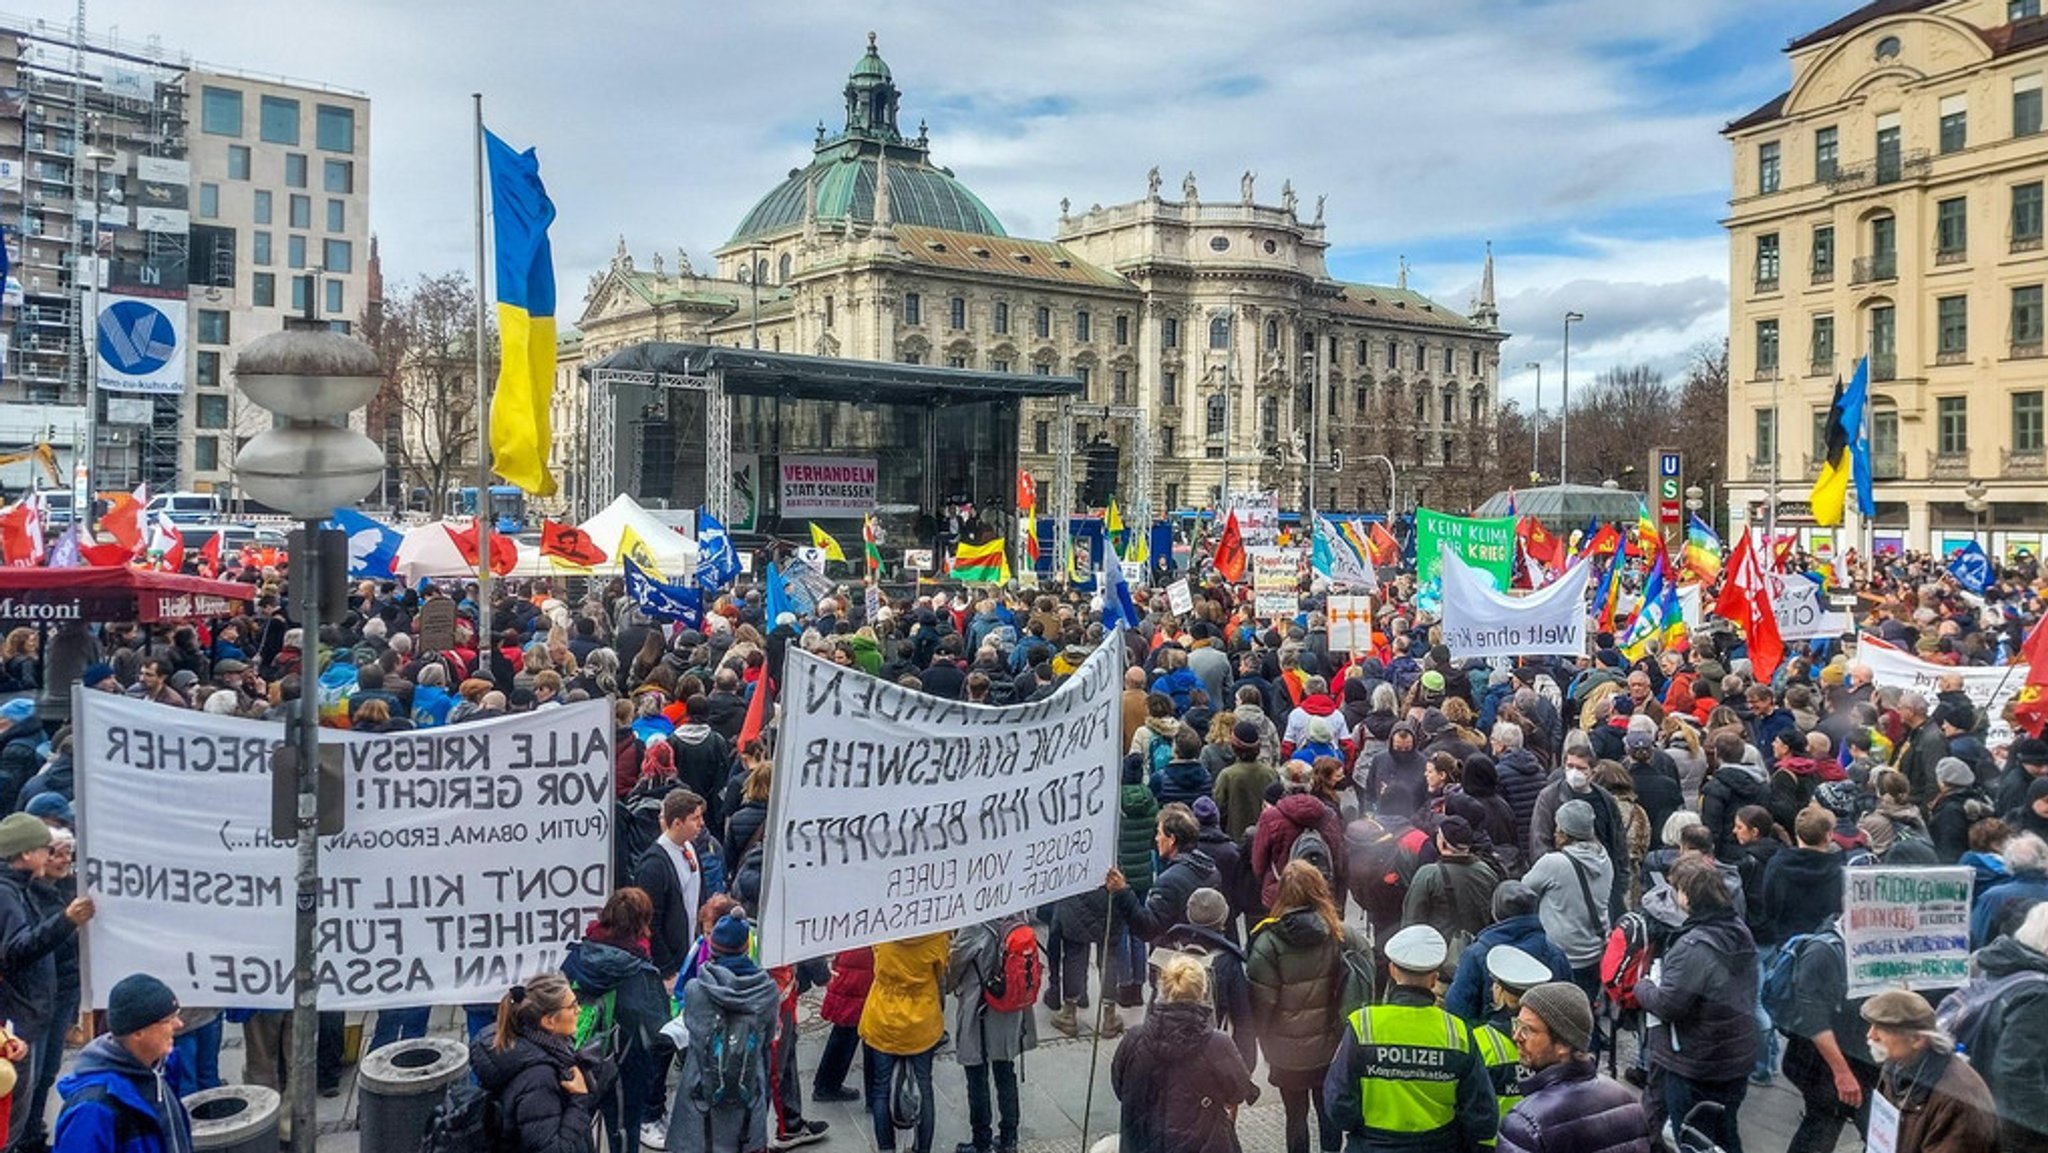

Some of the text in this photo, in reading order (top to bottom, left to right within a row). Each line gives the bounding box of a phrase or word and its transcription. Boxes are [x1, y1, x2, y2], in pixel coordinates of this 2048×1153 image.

[784, 465, 875, 483] VERHANDELN
[1665, 456, 1677, 474] U
[785, 484, 874, 498] STATT SCHIESSEN!
[1664, 479, 1677, 498] S
[1428, 518, 1508, 545] KEIN KLIMA
[1468, 544, 1506, 561] KRIEG
[1377, 1047, 1445, 1065] POLIZEI
[1366, 1064, 1456, 1082] Kommunikation
